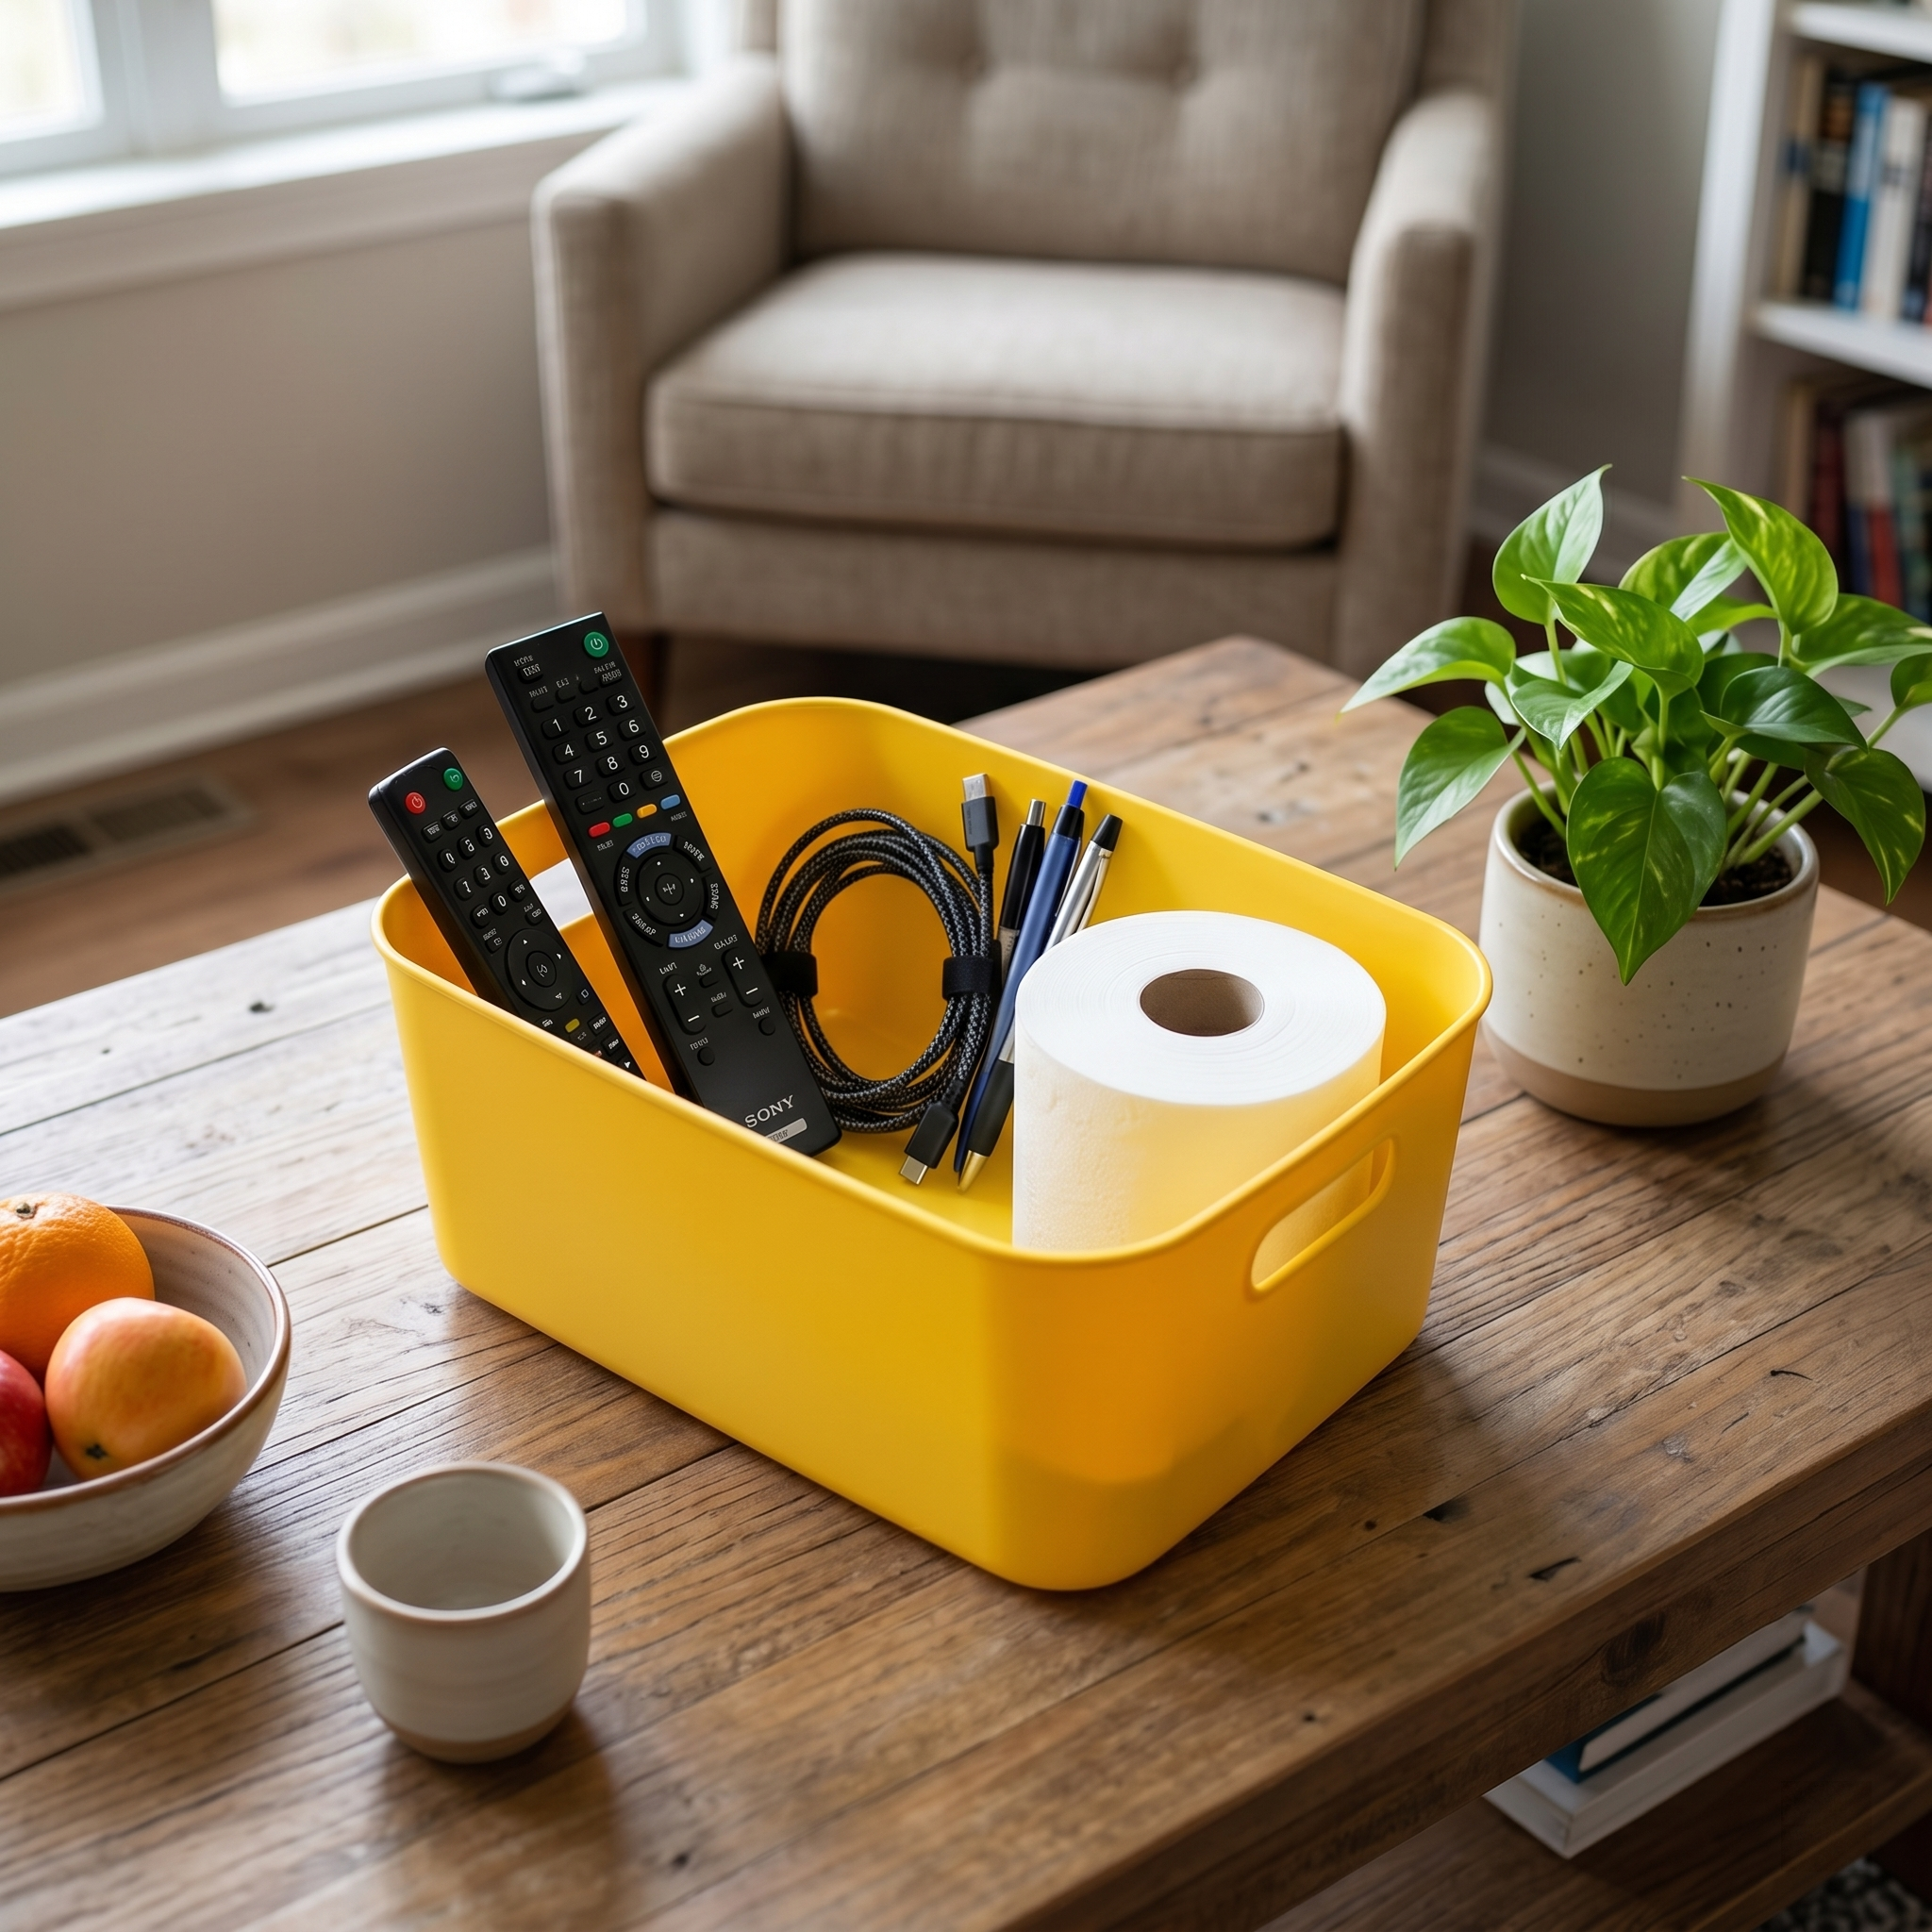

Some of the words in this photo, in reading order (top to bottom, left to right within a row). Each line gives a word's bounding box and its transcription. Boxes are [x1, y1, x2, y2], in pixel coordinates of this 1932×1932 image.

[553, 719, 562, 732] 1
[584, 707, 597, 721] 2
[617, 695, 628, 708] 3
[564, 744, 575, 757] 4
[595, 731, 608, 745] 5
[628, 720, 640, 733] 6
[574, 770, 583, 783] 7
[607, 757, 618, 770] 8
[639, 745, 650, 758] 9
[619, 782, 629, 795] 0
[746, 1095, 794, 1128] SONY
